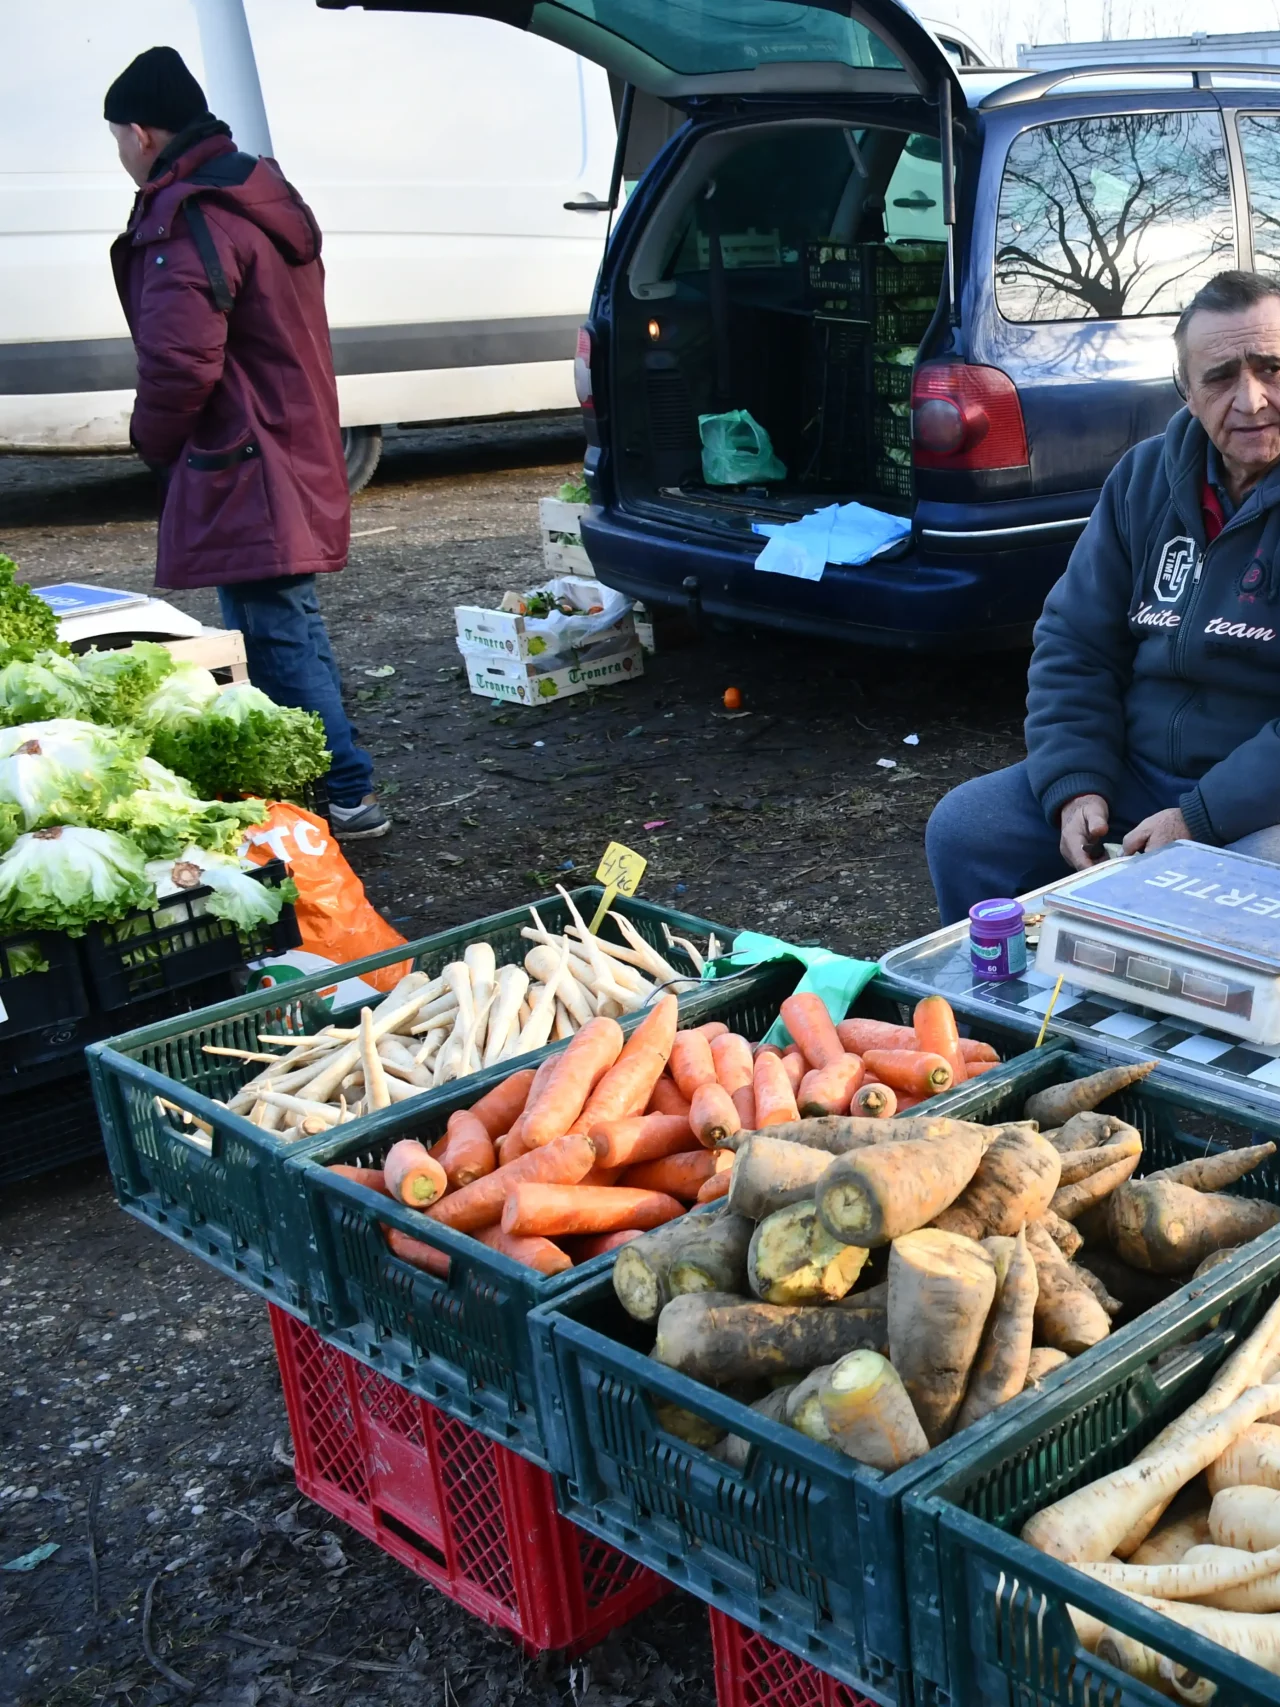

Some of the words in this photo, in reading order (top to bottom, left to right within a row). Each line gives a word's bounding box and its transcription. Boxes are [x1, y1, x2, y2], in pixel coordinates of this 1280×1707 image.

[1162, 551, 1177, 581] TIME
[464, 628, 506, 650] Tronera
[1204, 617, 1276, 642] team
[475, 673, 517, 695] Tronera
[568, 662, 622, 684] Tronera
[987, 965, 998, 973] 60
